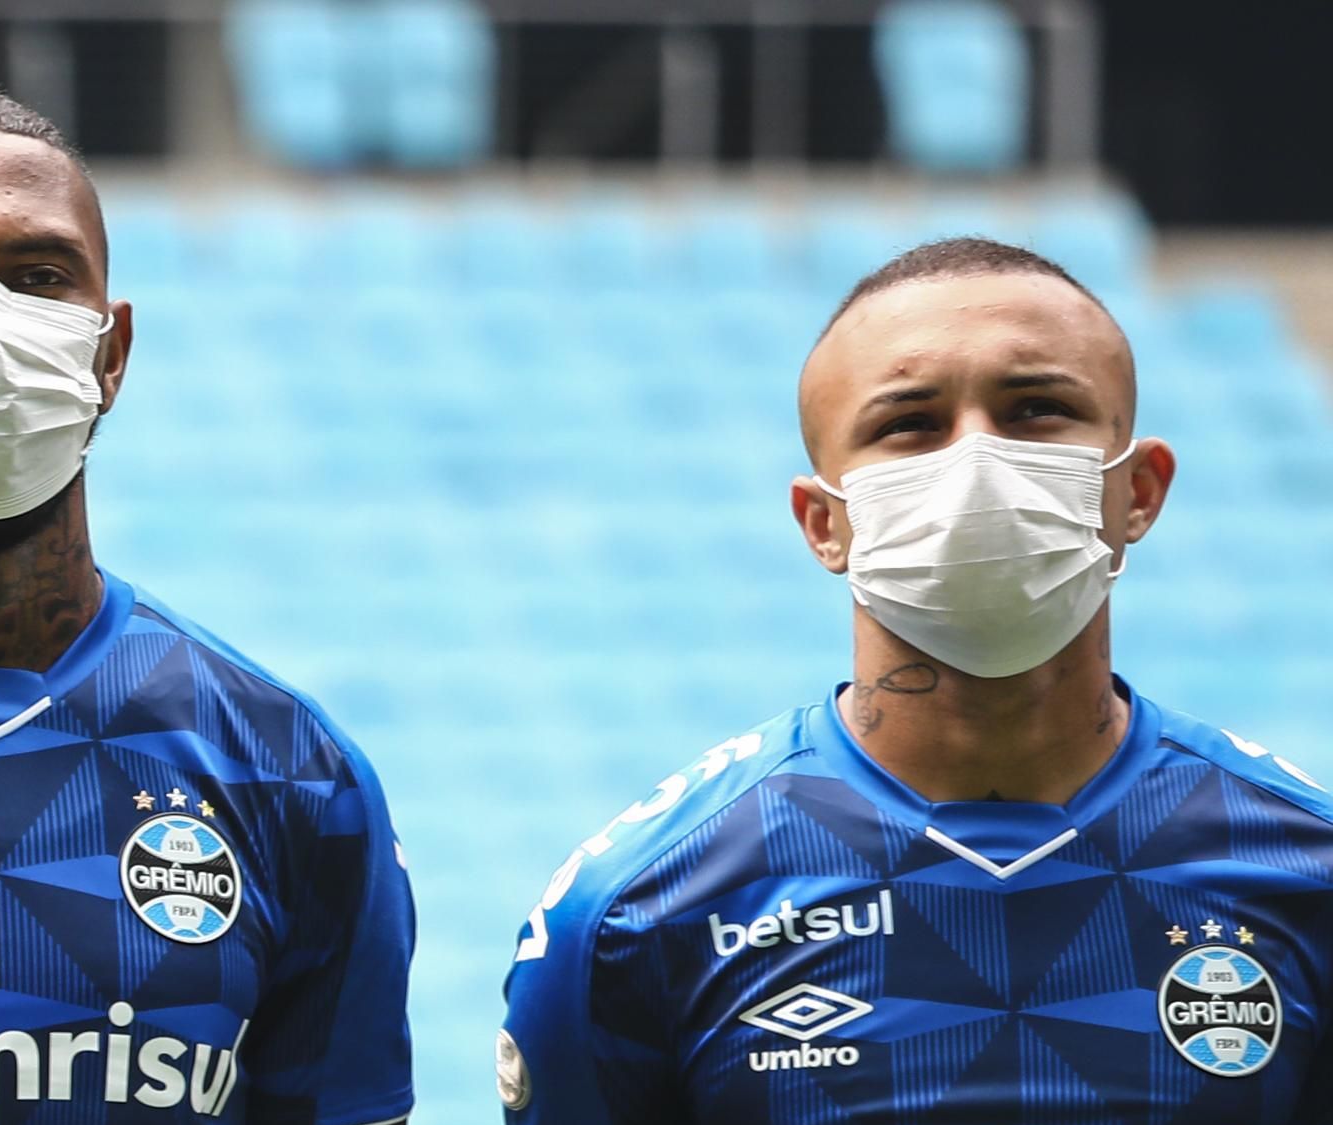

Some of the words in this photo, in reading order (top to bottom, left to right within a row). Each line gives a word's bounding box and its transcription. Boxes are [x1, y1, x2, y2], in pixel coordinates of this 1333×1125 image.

[168, 839, 195, 852] 1903
[128, 861, 234, 898] GRÊMIO
[708, 889, 895, 957] betsul
[1167, 993, 1276, 1026] GRÊMIO
[748, 1041, 861, 1072] umbro
